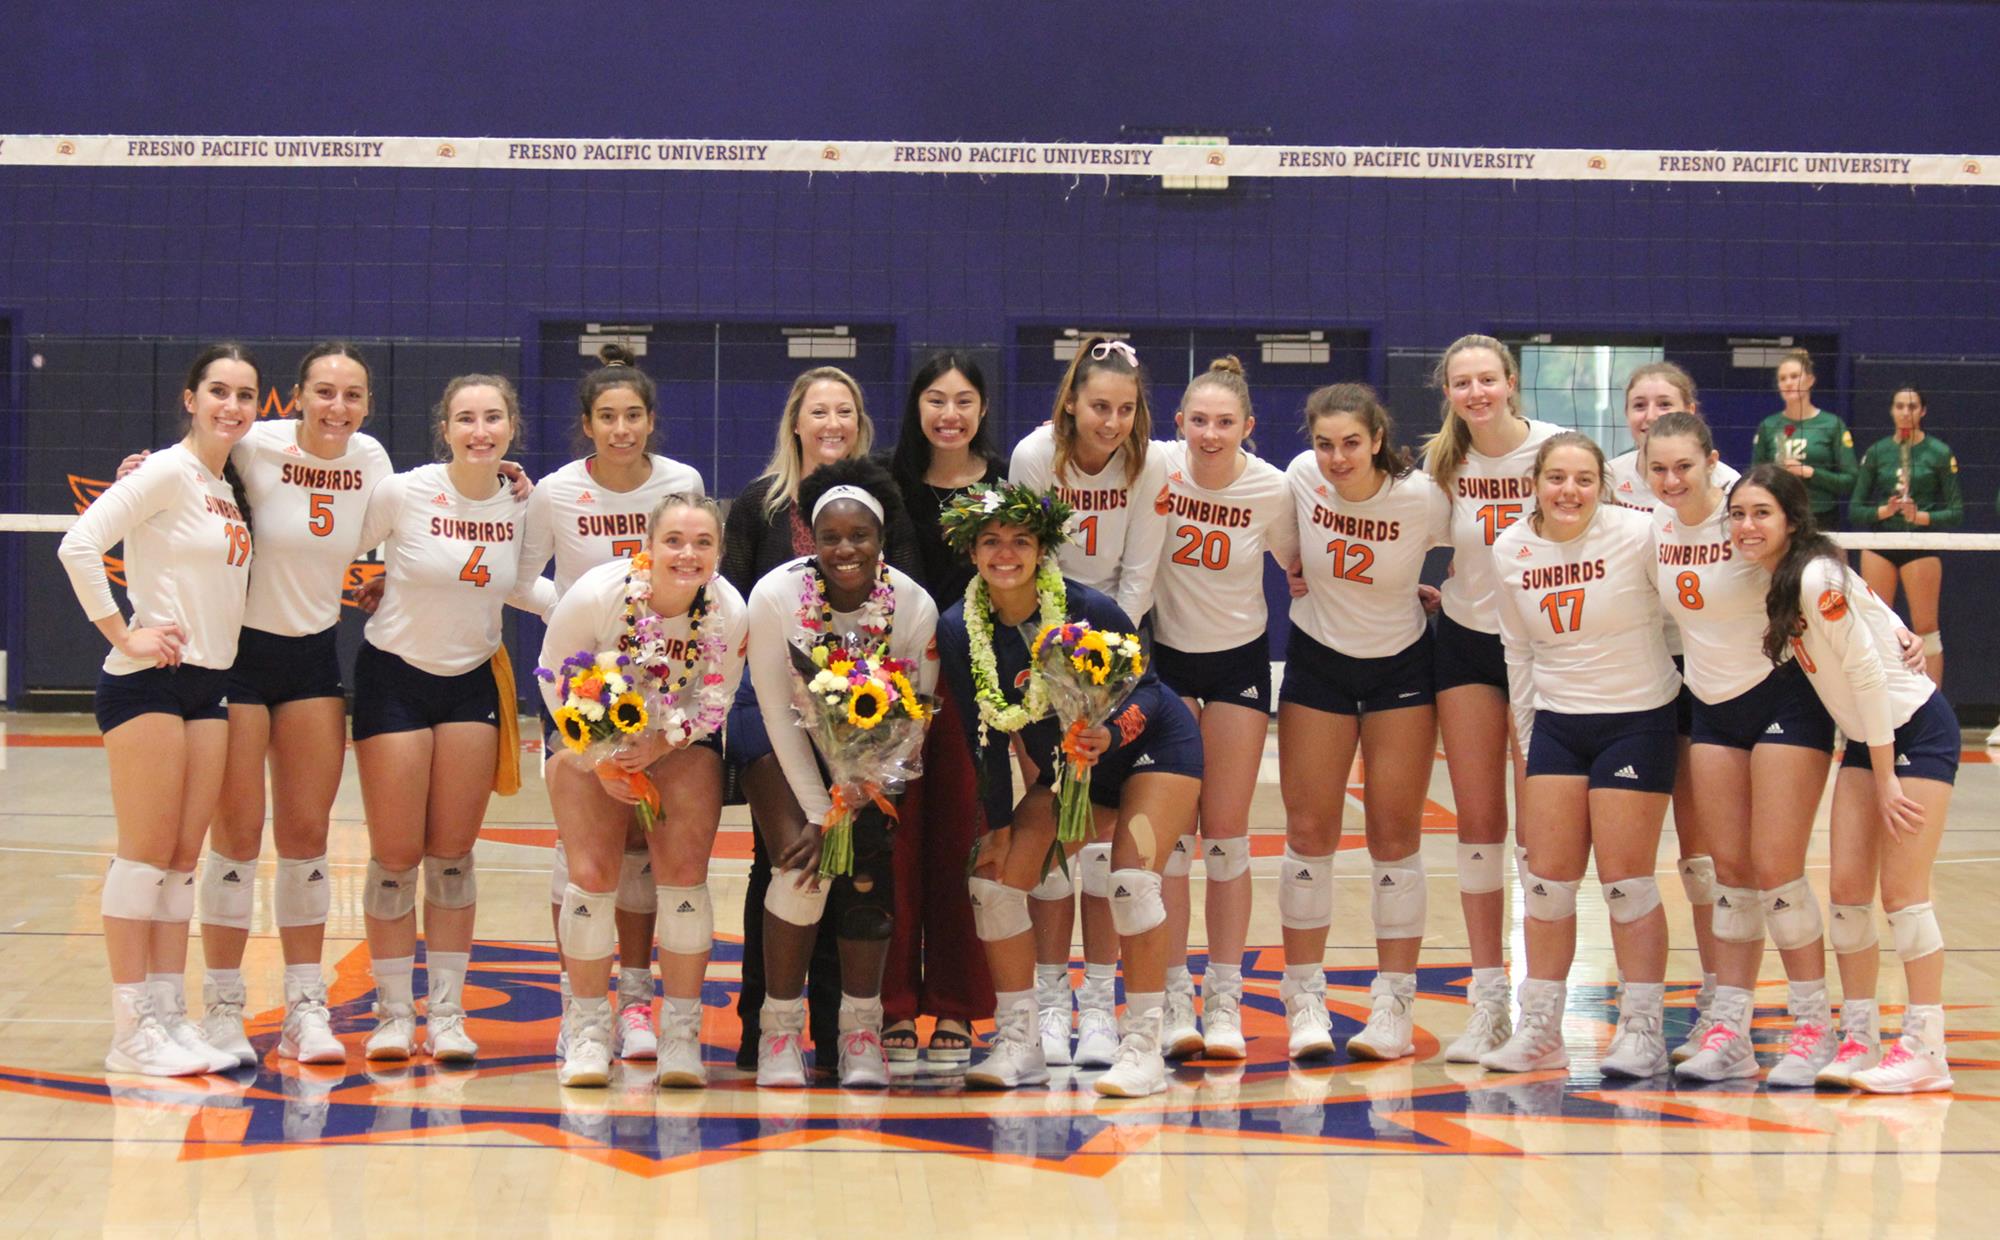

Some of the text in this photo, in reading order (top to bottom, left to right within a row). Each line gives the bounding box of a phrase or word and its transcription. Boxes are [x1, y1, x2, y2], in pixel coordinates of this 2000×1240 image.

[127, 141, 383, 158] FRESNO PACIFIC UNIVERSITY
[508, 143, 768, 161] FRESNO PACIFIC UNIVERSITY
[894, 146, 1153, 166] FRESNO PACIFIC UNIVERSITY
[1279, 151, 1535, 169] FRESNO PACIFIC UNIVERSITY
[1659, 156, 1911, 174] FRESNO PACIFIC UNIVERSITY
[282, 463, 363, 491] SUNBIRDS
[1458, 476, 1534, 500] SUNBIRD
[308, 493, 335, 537] 5
[577, 512, 647, 536] SUNBIR
[1167, 492, 1252, 528] SUNBIRDS
[1312, 504, 1400, 542] SUNBIRDS
[1476, 503, 1522, 546] 15
[224, 522, 250, 567] 19
[431, 516, 514, 543] SUNBIRDS
[1079, 515, 1098, 556] 1
[1172, 524, 1231, 570] 20
[1326, 538, 1375, 585] 12
[1658, 540, 1733, 566] SUNBIRDS
[459, 546, 491, 587] 4
[1521, 558, 1606, 591] SUNBIRDS
[1675, 570, 1705, 611] 8
[1540, 587, 1586, 634] 17
